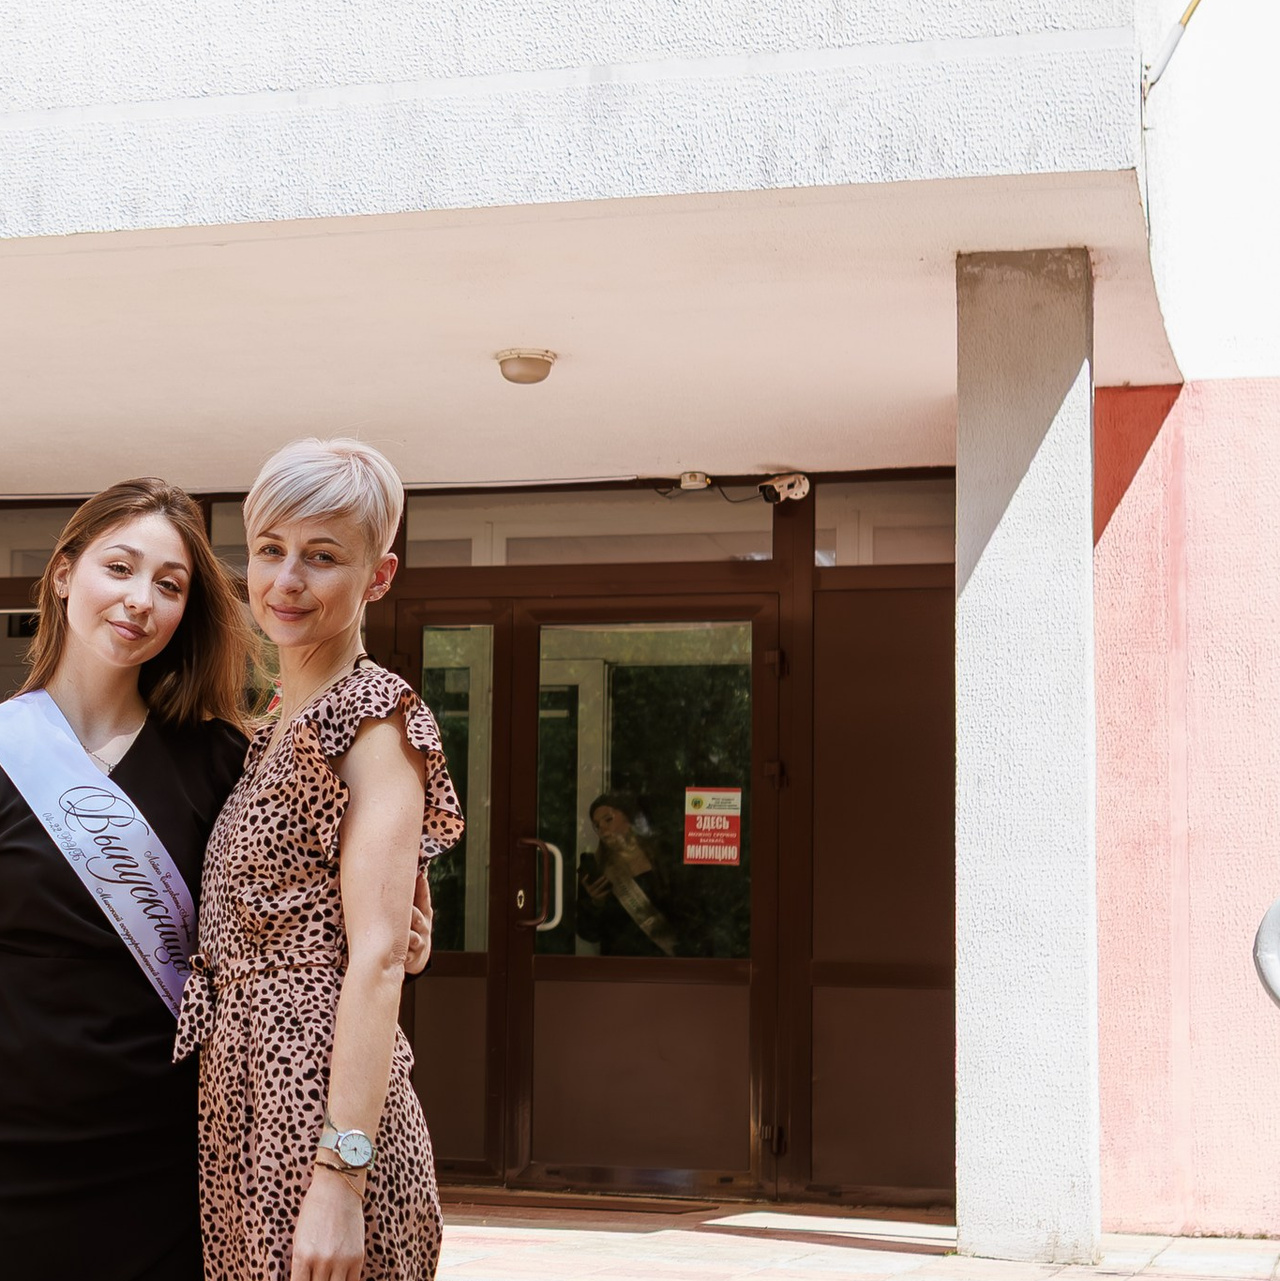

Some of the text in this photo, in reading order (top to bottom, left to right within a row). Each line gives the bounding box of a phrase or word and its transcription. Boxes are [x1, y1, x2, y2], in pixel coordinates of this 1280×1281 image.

[696, 815, 730, 831] ЗДЕСЬ
[686, 844, 738, 862] МИЛИЦИЮ
[58, 785, 188, 977] Выпускница
[96, 887, 124, 924] Минский
